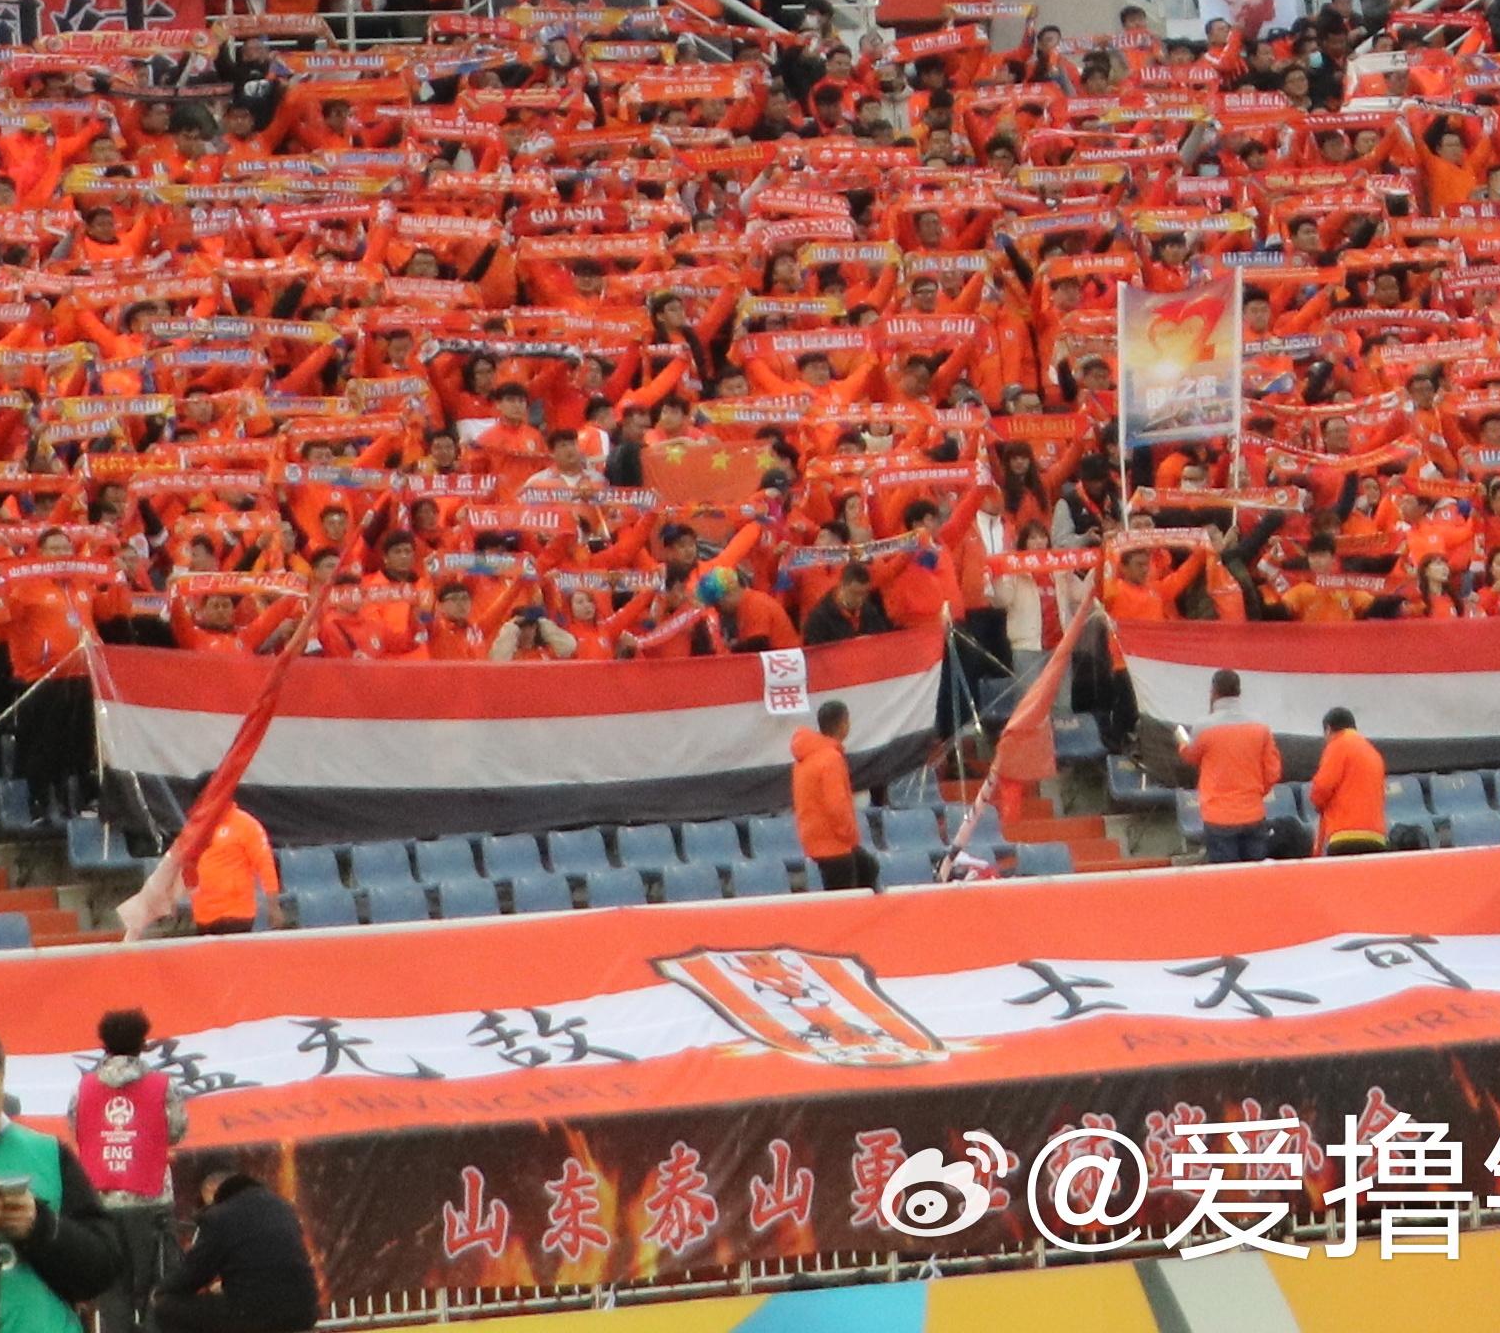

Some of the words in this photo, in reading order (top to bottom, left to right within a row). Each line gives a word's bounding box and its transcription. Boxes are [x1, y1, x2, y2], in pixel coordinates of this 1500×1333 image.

[530, 208, 556, 223] GO
[562, 207, 605, 223] ASIA
[102, 1145, 134, 1162] ENG
[442, 1085, 1422, 1259] 山东泰山勇球迷协会
